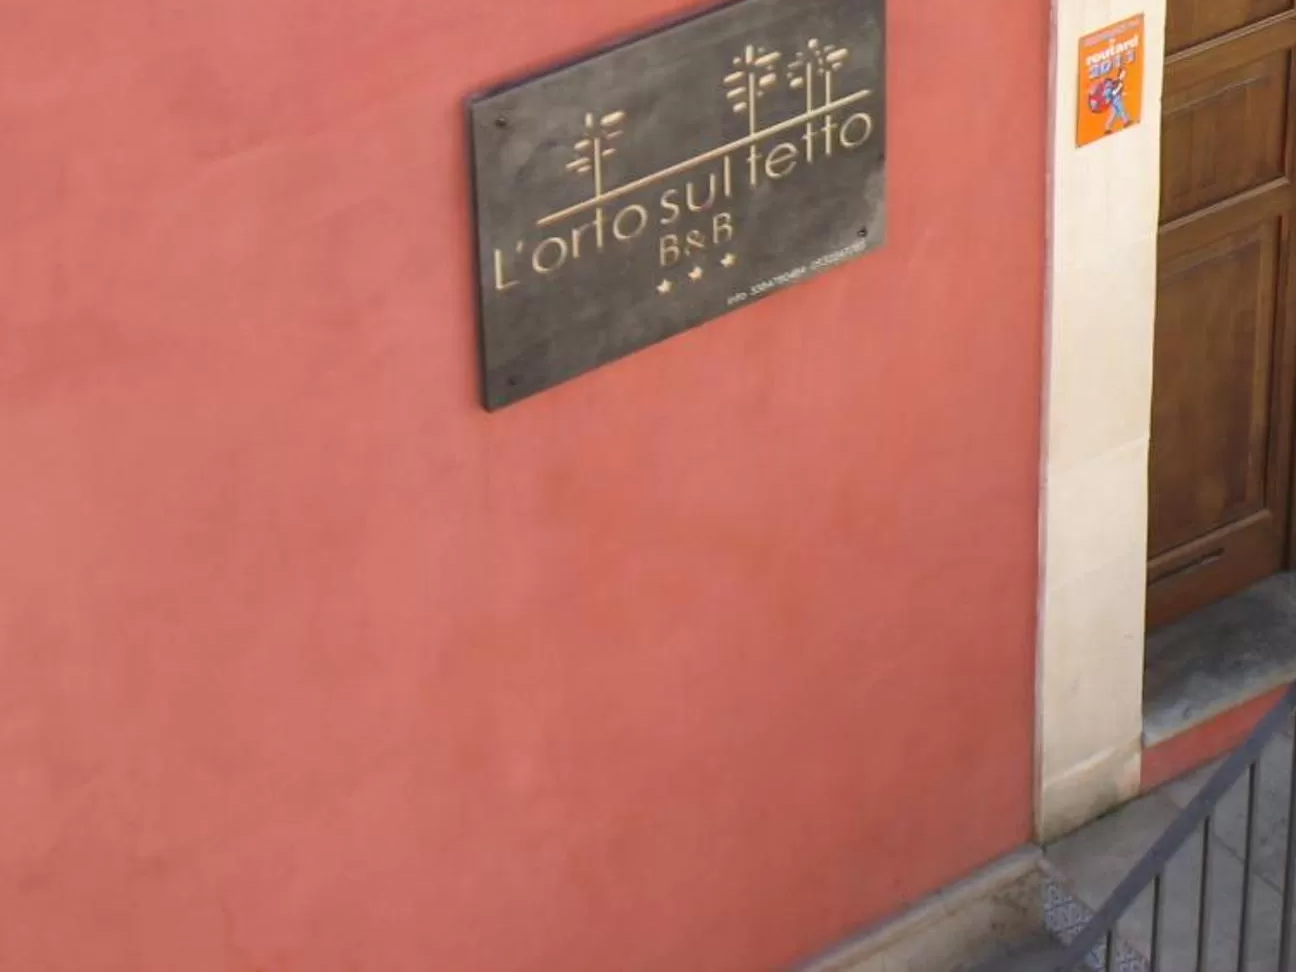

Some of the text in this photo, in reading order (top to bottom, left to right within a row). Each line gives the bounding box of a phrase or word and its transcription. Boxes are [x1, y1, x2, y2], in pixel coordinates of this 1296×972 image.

[494, 111, 873, 291] L'orto sul tetto
[659, 212, 733, 267] B&B
